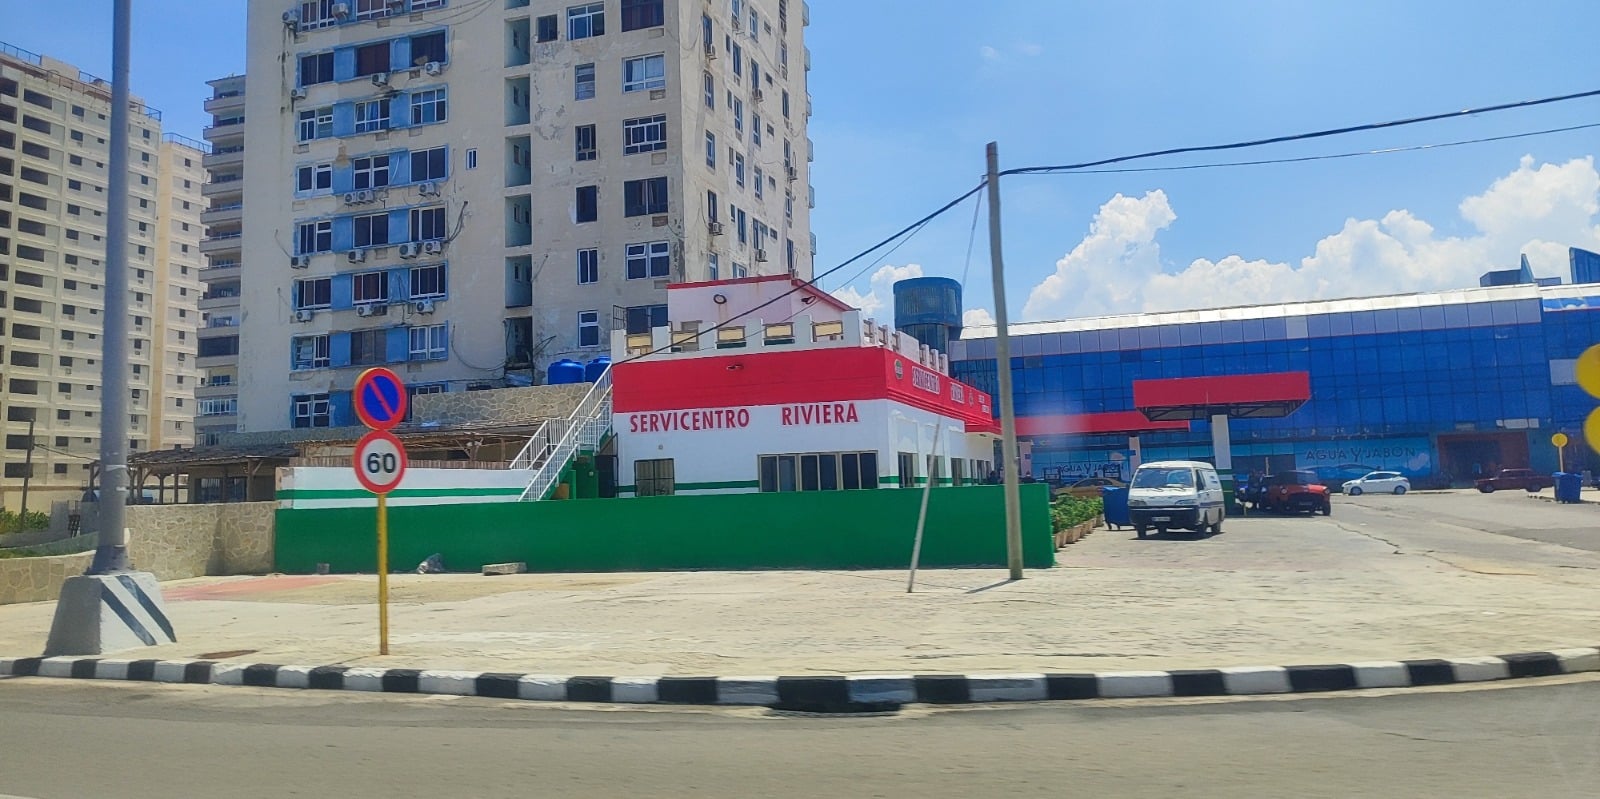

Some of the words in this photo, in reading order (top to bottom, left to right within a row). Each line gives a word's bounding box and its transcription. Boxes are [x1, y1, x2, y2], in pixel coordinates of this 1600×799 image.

[630, 408, 750, 433] SERVICENTRO
[781, 403, 859, 426] RIVIERA
[367, 452, 396, 474] 60
[1306, 448, 1347, 461] AGUA
[1350, 447, 1362, 462] Y
